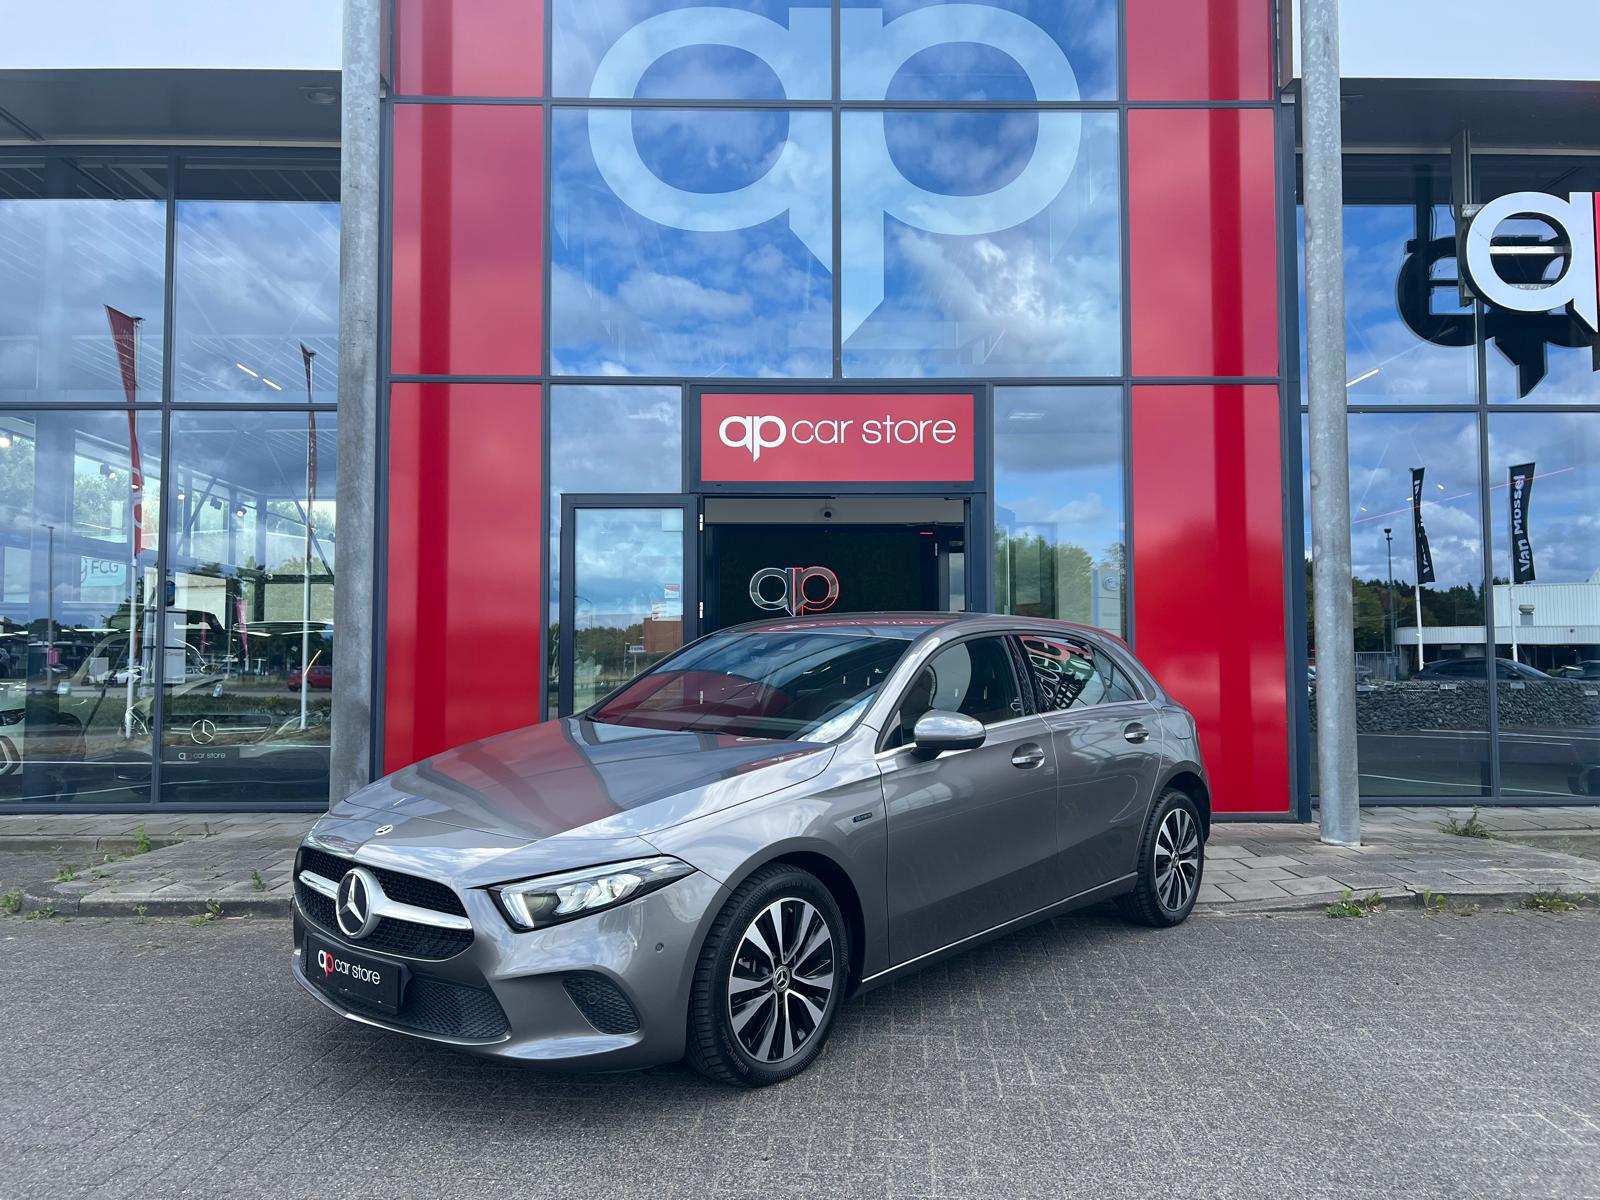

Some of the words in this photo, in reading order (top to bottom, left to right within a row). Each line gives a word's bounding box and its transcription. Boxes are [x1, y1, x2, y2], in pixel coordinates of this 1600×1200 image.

[791, 418, 854, 444] car
[861, 414, 957, 444] store
[91, 560, 119, 574] FCG
[1518, 539, 1530, 573] Van
[334, 959, 351, 975] car
[351, 964, 381, 985] store
